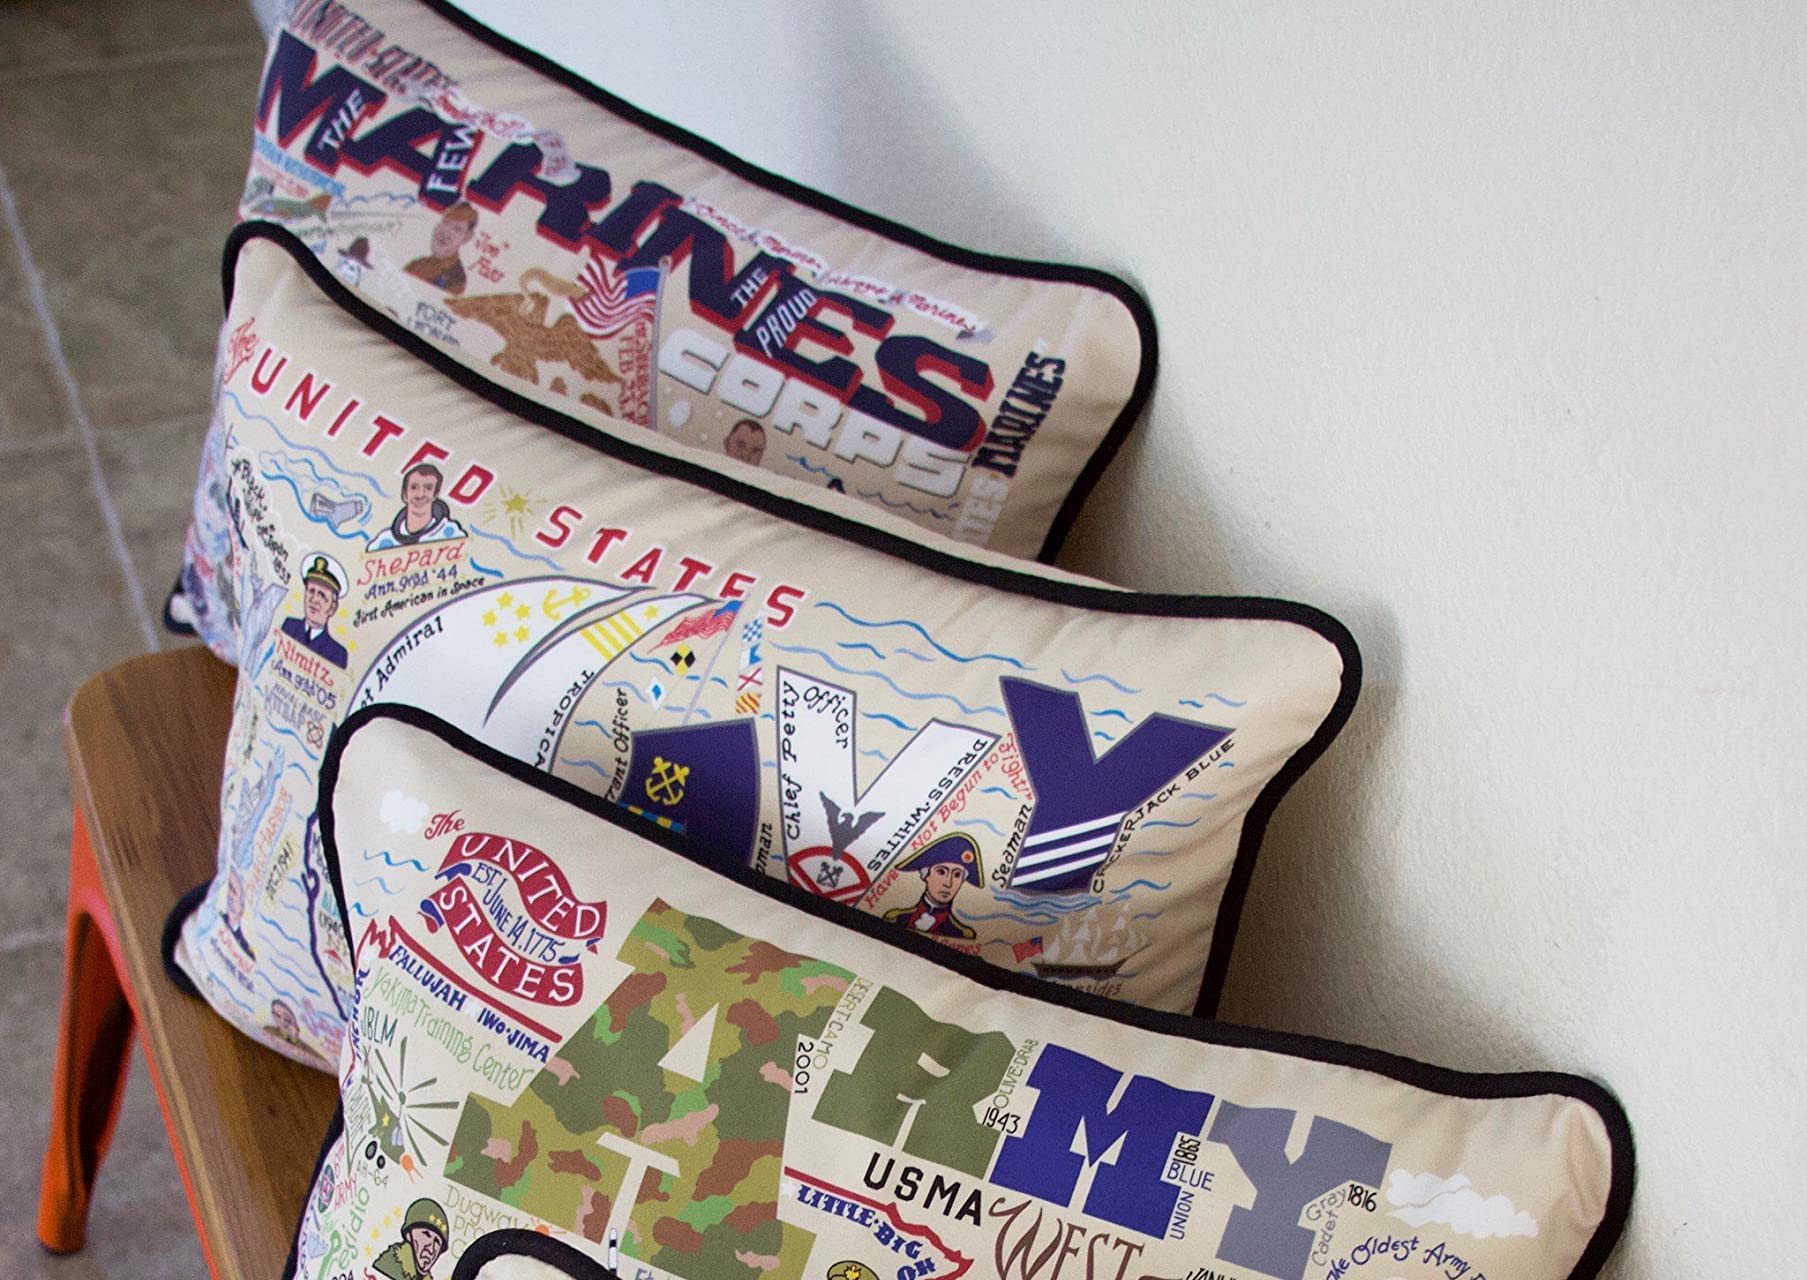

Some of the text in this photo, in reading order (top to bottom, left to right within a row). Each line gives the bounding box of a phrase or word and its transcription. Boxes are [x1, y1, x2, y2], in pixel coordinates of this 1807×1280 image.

[316, 88, 365, 152] THE
[426, 122, 478, 194] FEW
[729, 267, 769, 309] THE
[755, 290, 817, 358] PROUD
[658, 330, 969, 498] CORPS
[380, 574, 486, 619] American Space
[273, 629, 335, 688] Nimitz
[376, 615, 446, 691] Admiral
[534, 668, 597, 768] TROPICA
[613, 687, 631, 754] Officer
[781, 680, 850, 842] Chief Petty Officer
[1184, 738, 1236, 784] BLUE
[424, 810, 466, 840] The
[865, 751, 1000, 909] Have Not Begun to
[866, 738, 989, 873] DRESS WHITES
[991, 804, 1033, 889] Seaman
[460, 836, 602, 938] UNITED
[482, 877, 513, 933] JUNE
[439, 886, 574, 1002] STATES
[388, 945, 467, 1011] FALLUJAH
[361, 1005, 398, 1048] JBLM
[364, 966, 535, 1093] Yakima Training Center
[793, 1041, 814, 1095] 2001
[981, 1106, 1021, 1135] 1943
[356, 1160, 390, 1189] AH-64
[863, 1152, 983, 1227] USMA
[1166, 1162, 1215, 1191] BLUE
[1304, 1186, 1348, 1222] Gray
[1347, 1184, 1377, 1213] 1816
[1169, 1191, 1195, 1240] UNION
[1311, 1209, 1340, 1267] Cadet
[1350, 1235, 1470, 1280] Oldest Army
